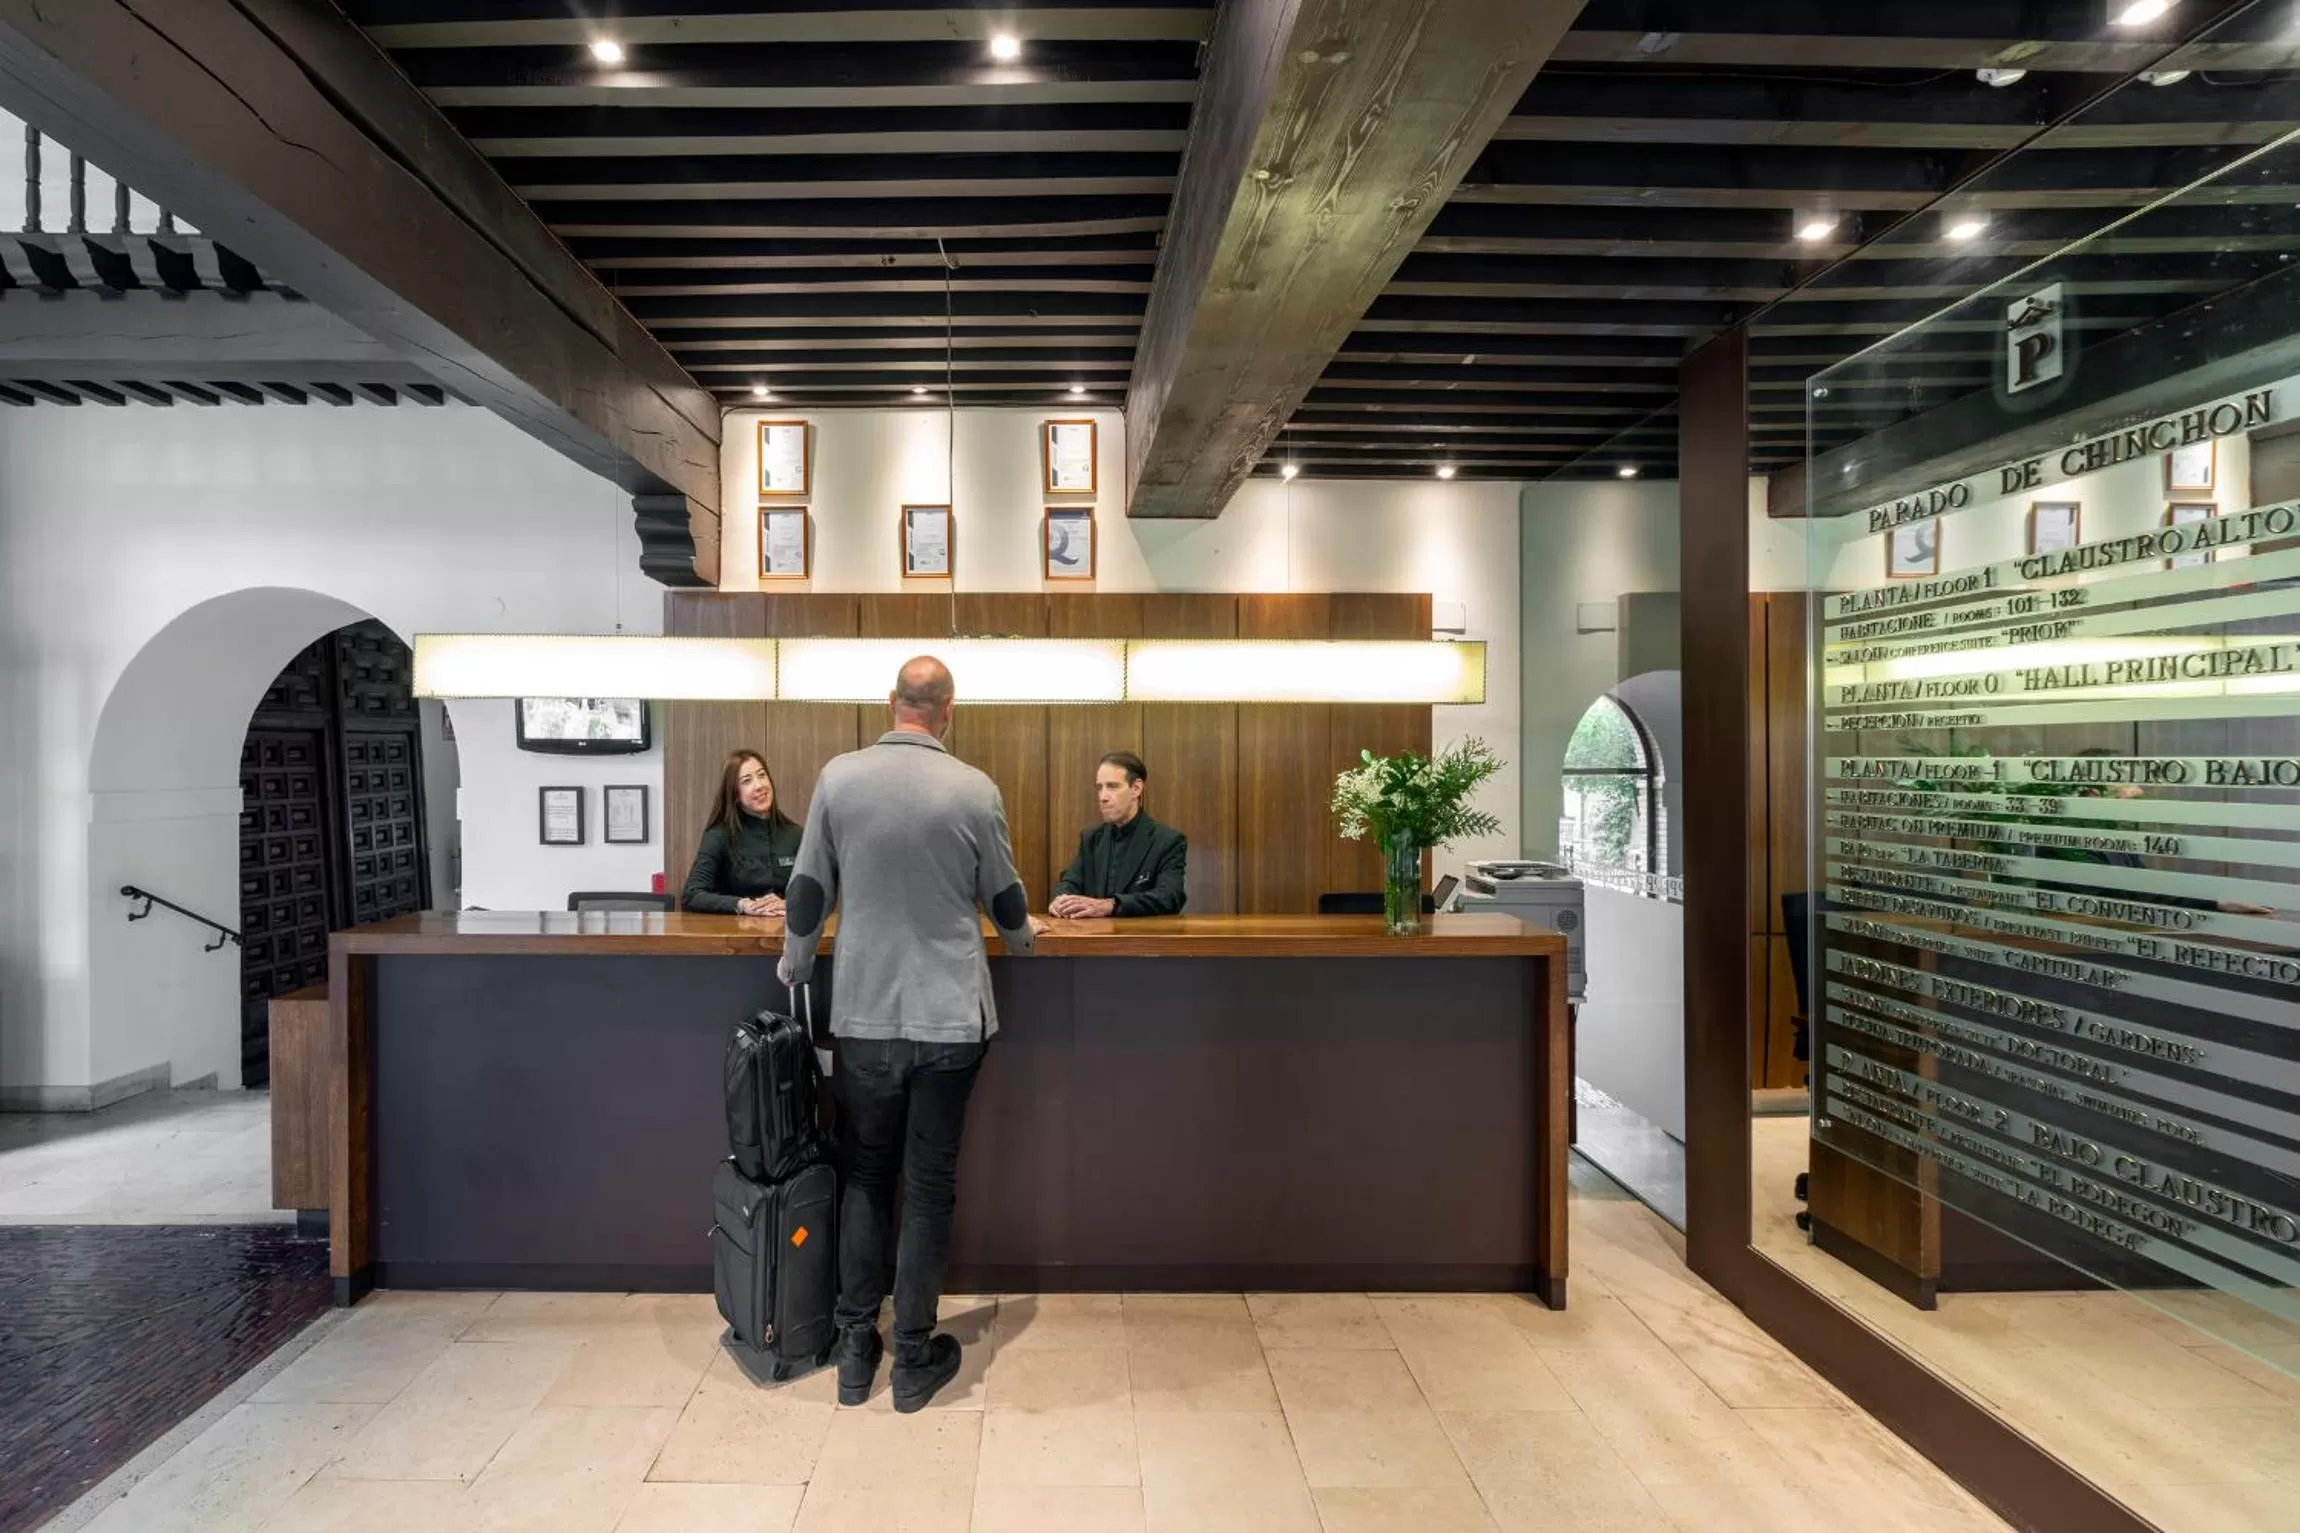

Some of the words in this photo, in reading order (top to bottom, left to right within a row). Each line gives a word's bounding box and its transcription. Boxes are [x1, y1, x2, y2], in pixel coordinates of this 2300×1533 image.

[2014, 332, 2054, 386] P
[2001, 459, 2042, 495] DE
[2060, 390, 2273, 476] CHINCHON
[1840, 586, 1910, 614] PLANTA
[1924, 574, 1978, 600] FLOOR
[1983, 567, 1993, 588] 1
[2006, 595, 2034, 616] 101
[2051, 588, 2086, 609] 132
[1841, 680, 1912, 704] PLANTA
[1925, 679, 1979, 698] FLOOR
[1840, 760, 1910, 778] PLANTA
[1925, 763, 1979, 780] FLOOR
[2205, 759, 2300, 785] BAJO
[1928, 819, 2000, 840] PREMIUM
[2114, 1154, 2297, 1242] CLAUSTRO
